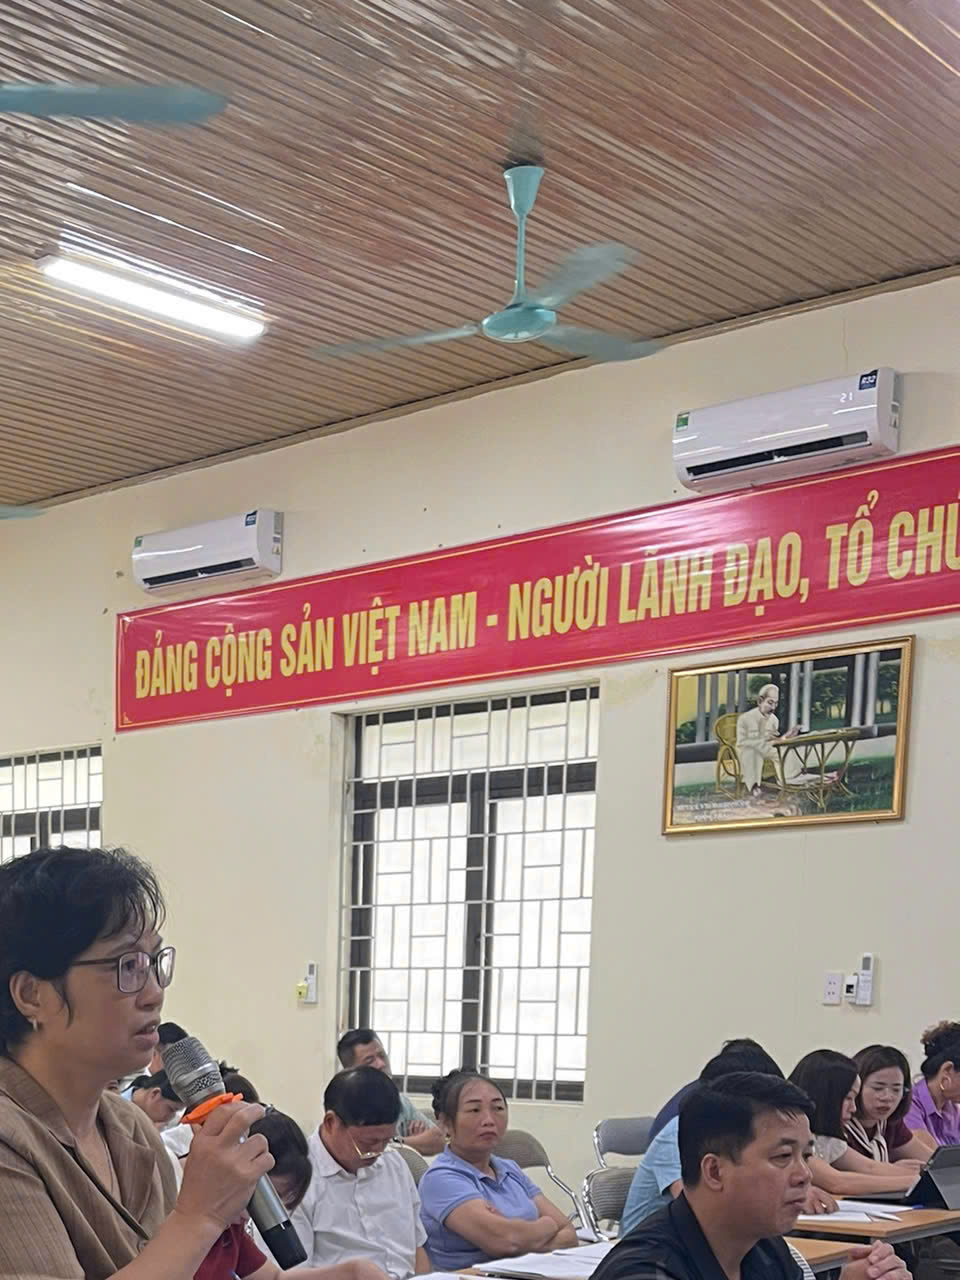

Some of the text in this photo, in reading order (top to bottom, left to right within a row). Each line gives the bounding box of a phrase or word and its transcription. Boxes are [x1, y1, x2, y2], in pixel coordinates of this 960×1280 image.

[136, 630, 198, 699] ĐẢNG
[205, 624, 273, 697] CỘNG
[280, 602, 335, 678] SẢN
[342, 596, 401, 675] VIỆT
[408, 591, 478, 657] NAM
[486, 614, 499, 627] -
[507, 555, 610, 641] NGƯỜI
[619, 547, 713, 624] LÃNH
[723, 532, 810, 616] ĐẠO,
[826, 489, 879, 590] TỔ
